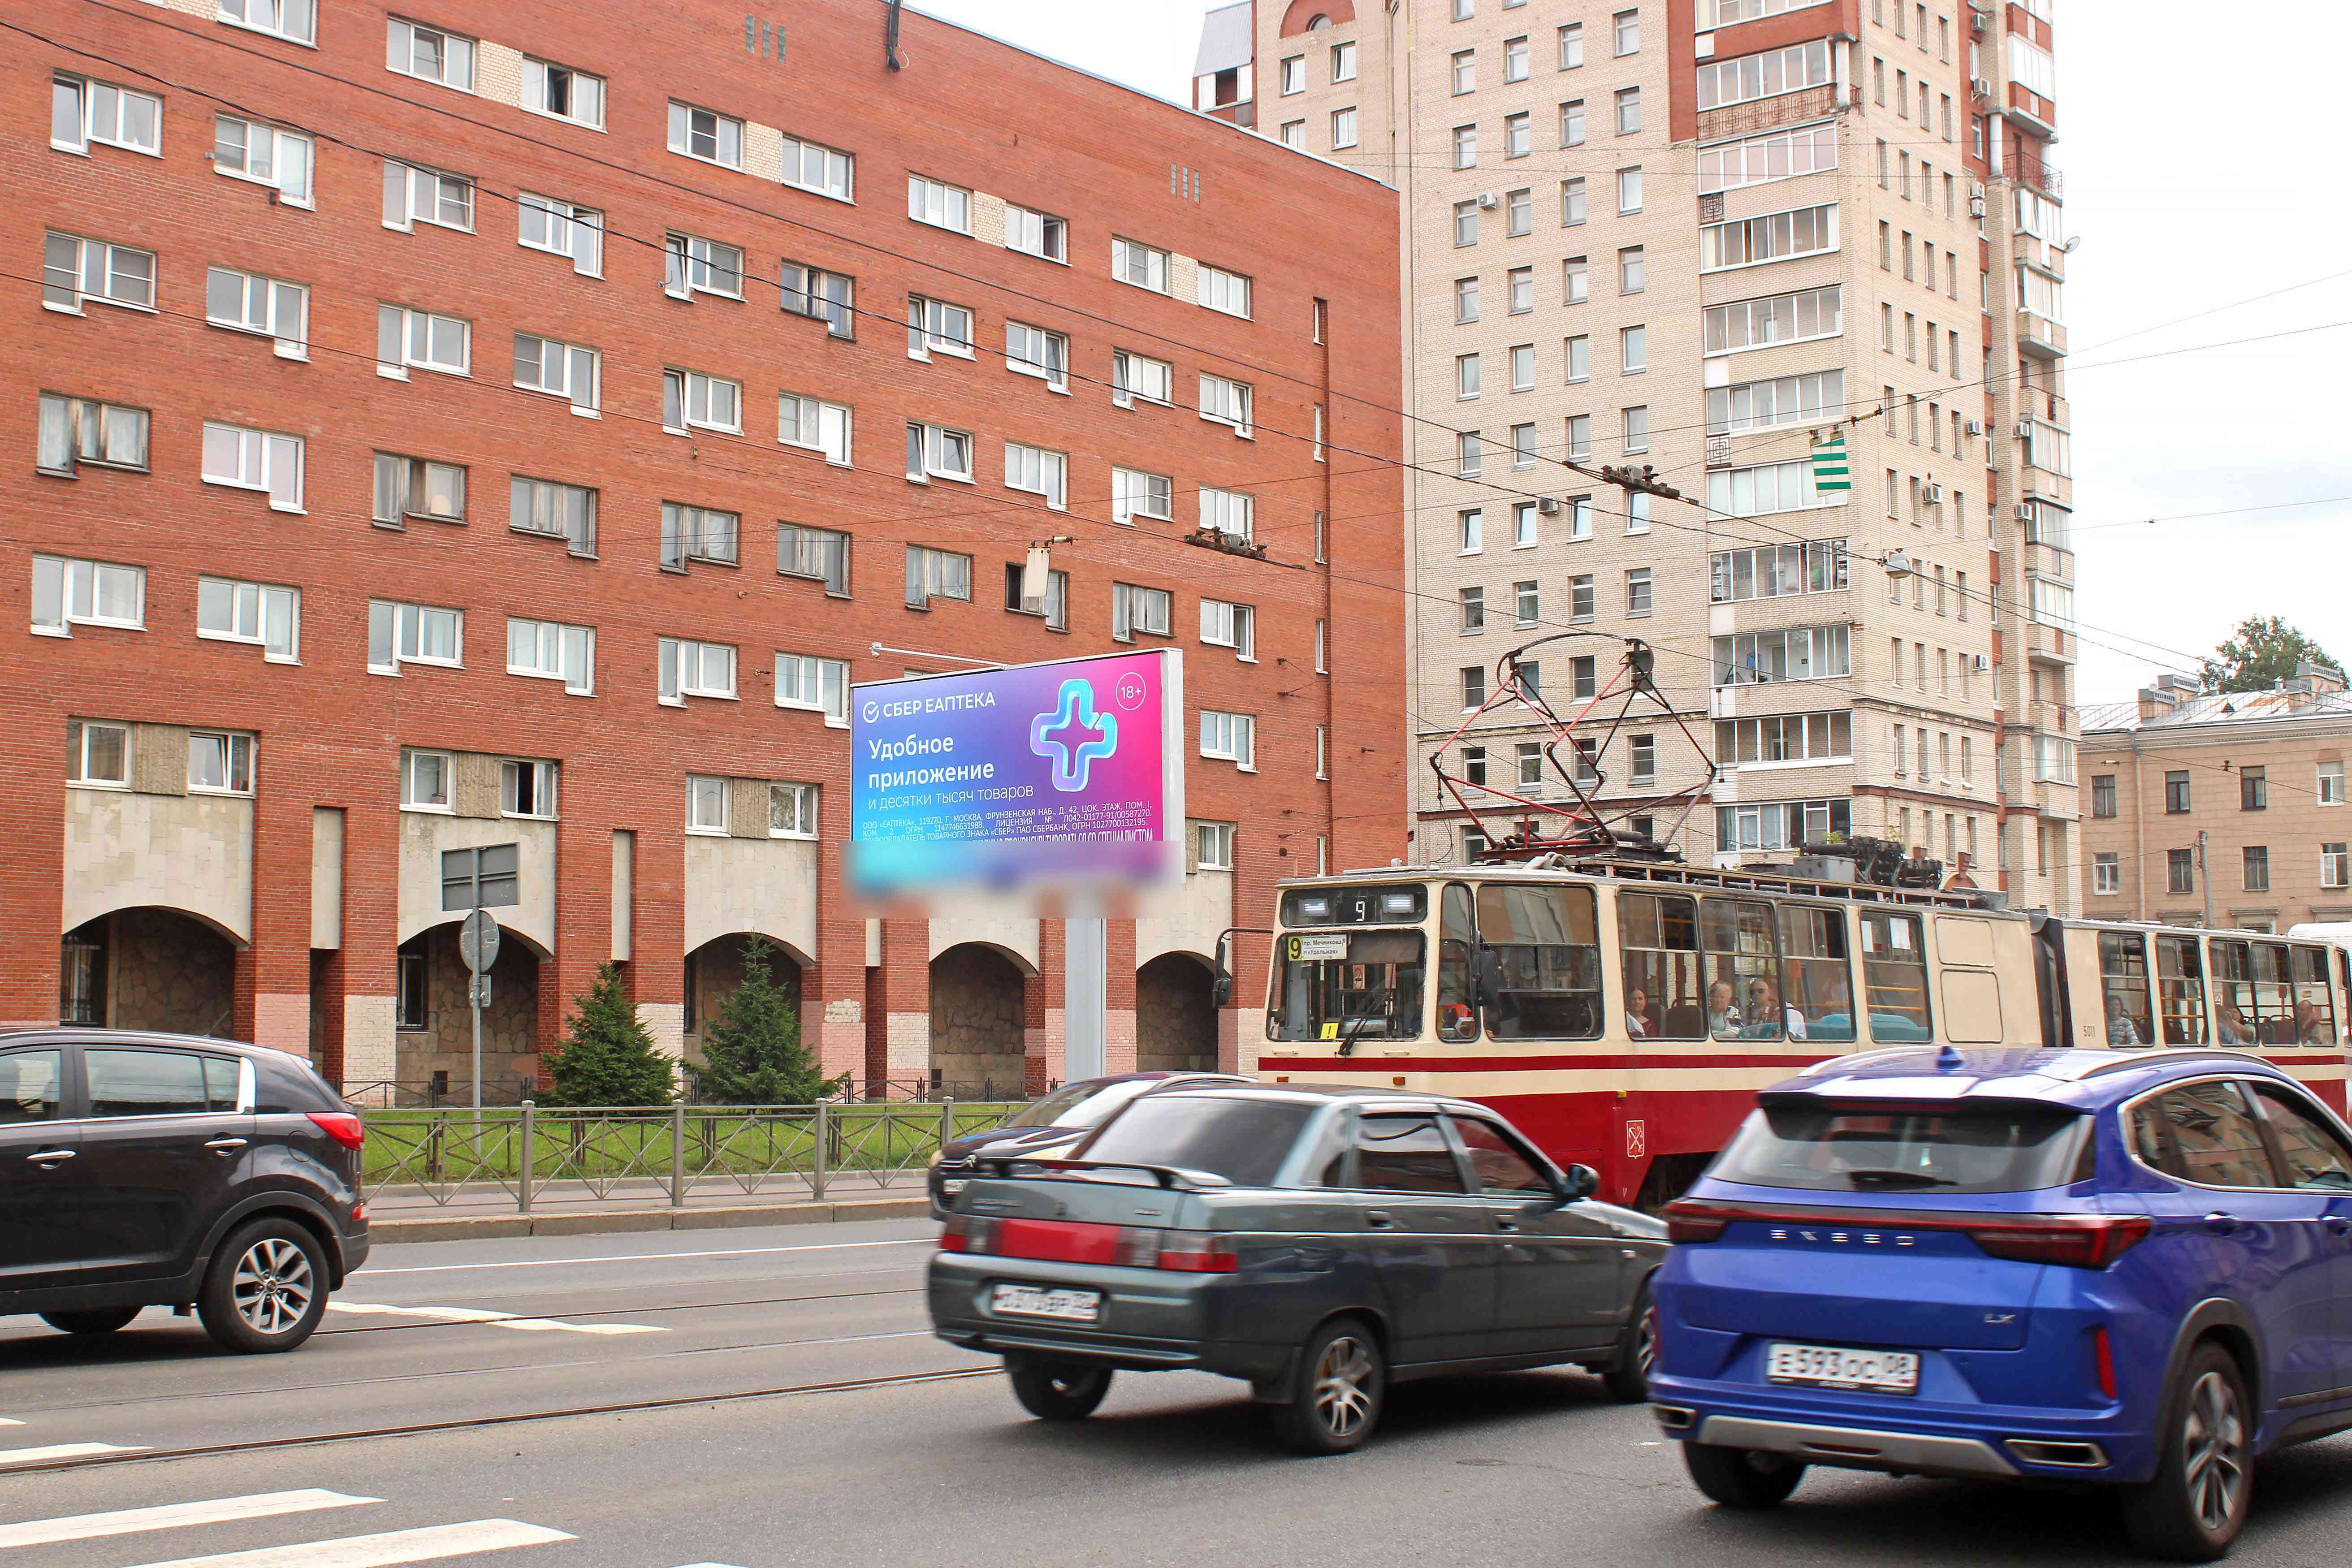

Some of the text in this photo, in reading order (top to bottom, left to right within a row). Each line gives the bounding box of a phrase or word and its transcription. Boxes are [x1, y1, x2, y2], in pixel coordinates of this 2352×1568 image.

[1121, 685, 1141, 700] 18+
[883, 691, 996, 717] СБЕР ЕАПТЕКА
[868, 734, 954, 761] Удобное
[869, 762, 994, 793] приложение
[869, 785, 1033, 811] и десятки тысяч товаров
[953, 813, 983, 822] МОСКВА,
[986, 808, 1035, 820] ФРУНЗЕНСКАЯ
[1038, 807, 1056, 816] НАБ.,
[1059, 807, 1066, 815] Д.
[1068, 806, 1079, 814] 42,
[1082, 804, 1099, 813] ЦОК.
[1102, 803, 1123, 811] ЭТАЖ,
[1125, 801, 1145, 809] ПОМ.
[995, 817, 1033, 828] ЛИЦЕНЗИЯ
[1044, 816, 1052, 824] №
[926, 830, 965, 840] ТОВАРНОГО
[967, 829, 989, 838] ЗНАКА
[990, 827, 1015, 836] «СБЕР»
[1016, 825, 1031, 834] ПАО
[1032, 823, 1070, 833] СБЕРБАНК,
[1072, 821, 1091, 830] ОГРН
[1355, 901, 1366, 922] 9
[1290, 937, 1301, 959] 9
